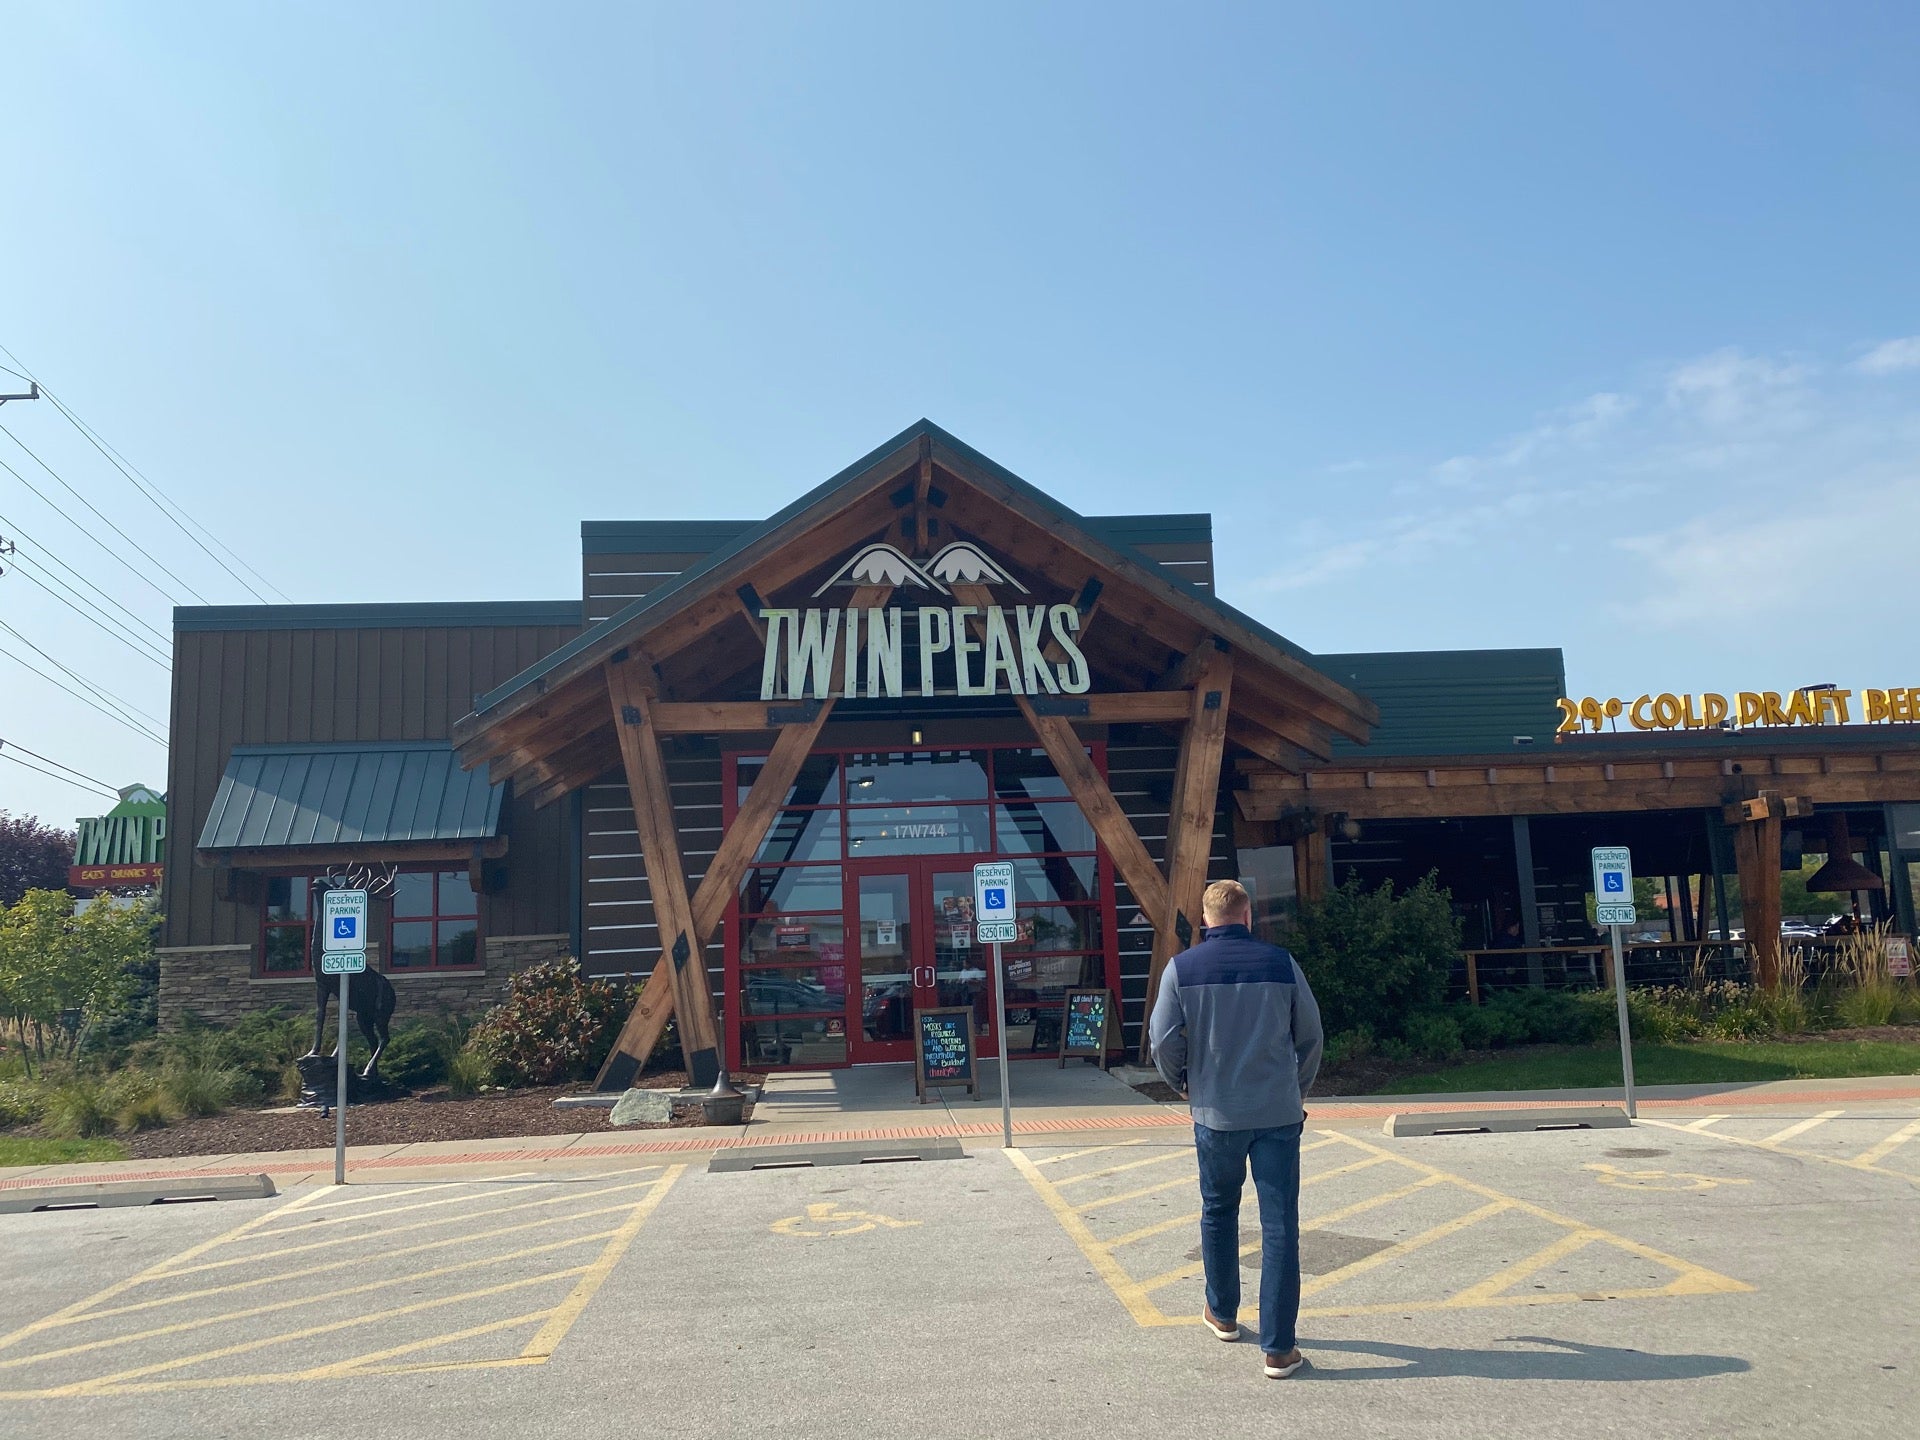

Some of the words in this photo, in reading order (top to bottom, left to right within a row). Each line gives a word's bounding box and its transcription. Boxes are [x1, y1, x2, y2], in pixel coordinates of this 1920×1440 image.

[759, 607, 902, 700] TWIN
[918, 603, 1091, 697] PEAKS
[1629, 692, 1729, 730] COLD
[1734, 689, 1852, 726] DRAFT
[893, 823, 945, 839] 17W744
[72, 815, 144, 866] TWIN
[1595, 852, 1627, 861] RESERVED
[1598, 862, 1626, 870] PARKING
[977, 868, 1011, 877] RESERVED
[980, 878, 1008, 887] PARKING
[327, 895, 364, 905] RESERVED
[330, 906, 361, 915] PARKING
[1600, 909, 1617, 920] $250
[1618, 909, 1633, 920] FINE
[980, 926, 998, 938] $250
[999, 926, 1014, 938] FINE
[325, 957, 345, 969] $250
[346, 956, 362, 968] FINE
